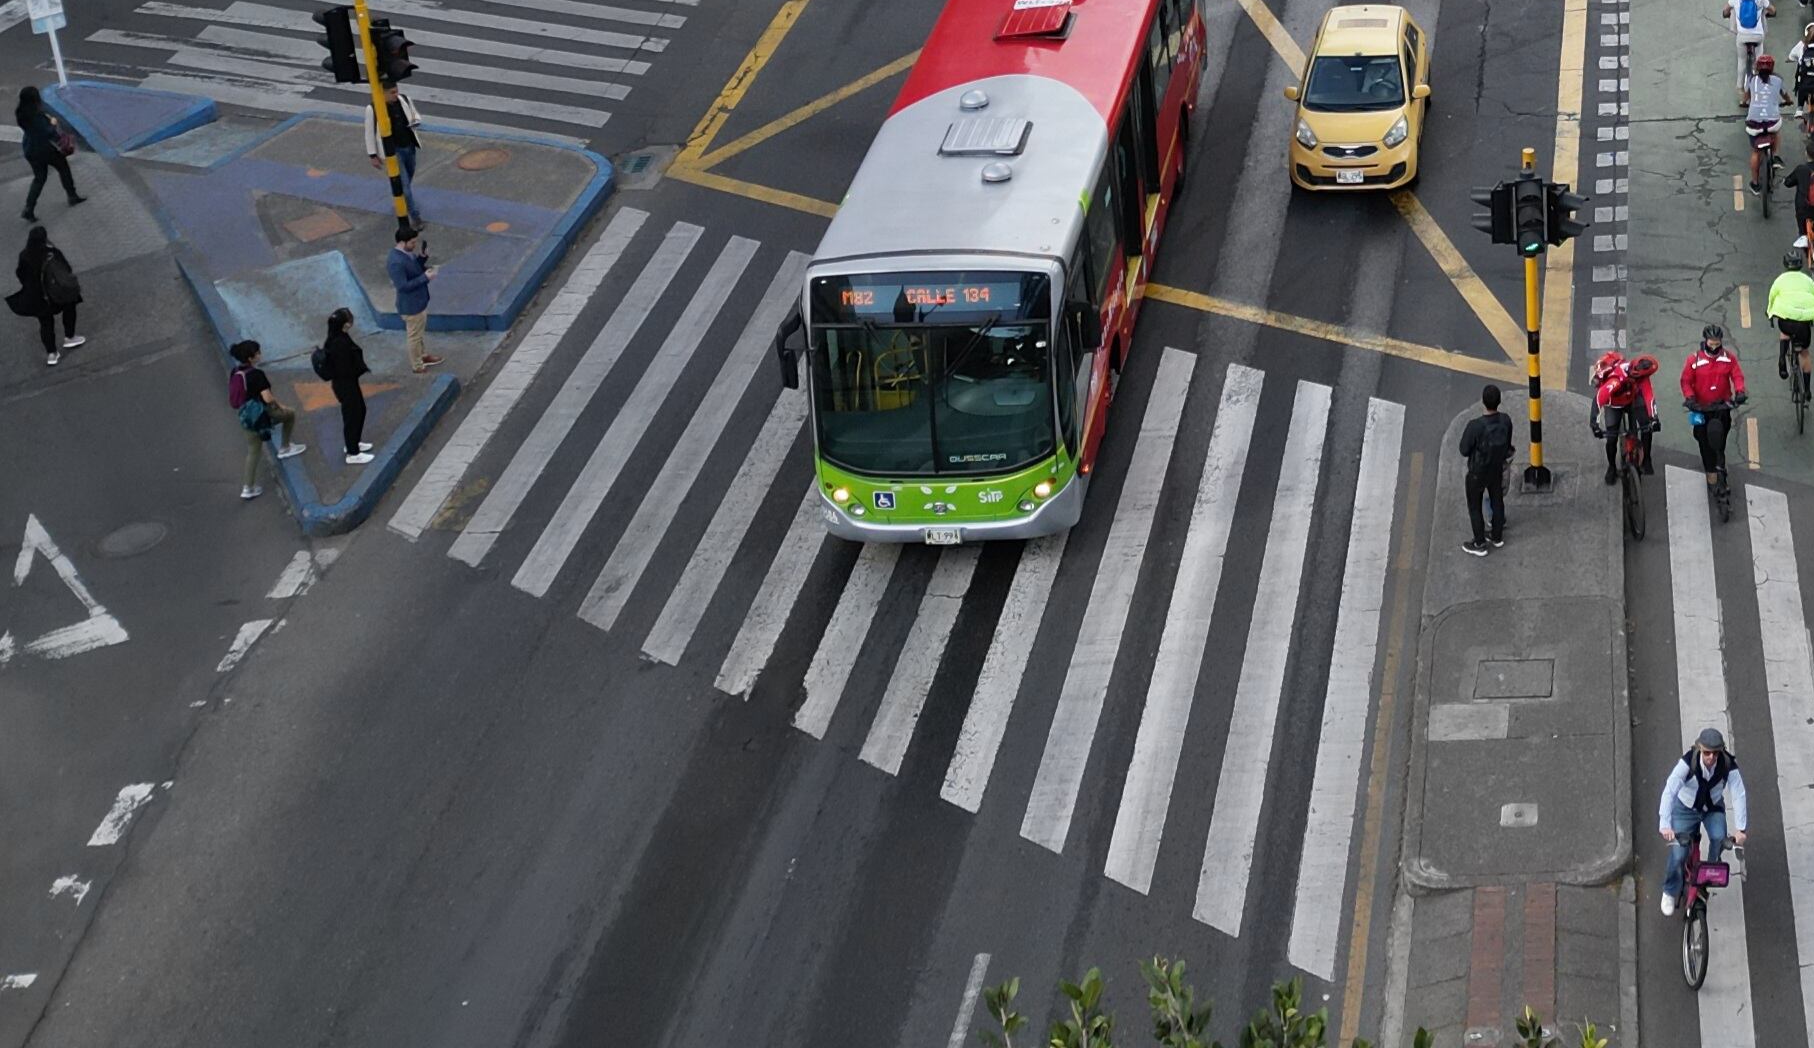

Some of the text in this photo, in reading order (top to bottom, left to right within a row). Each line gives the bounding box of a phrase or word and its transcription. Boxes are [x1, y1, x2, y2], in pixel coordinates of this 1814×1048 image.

[838, 287, 990, 305] M82 CALLE 134
